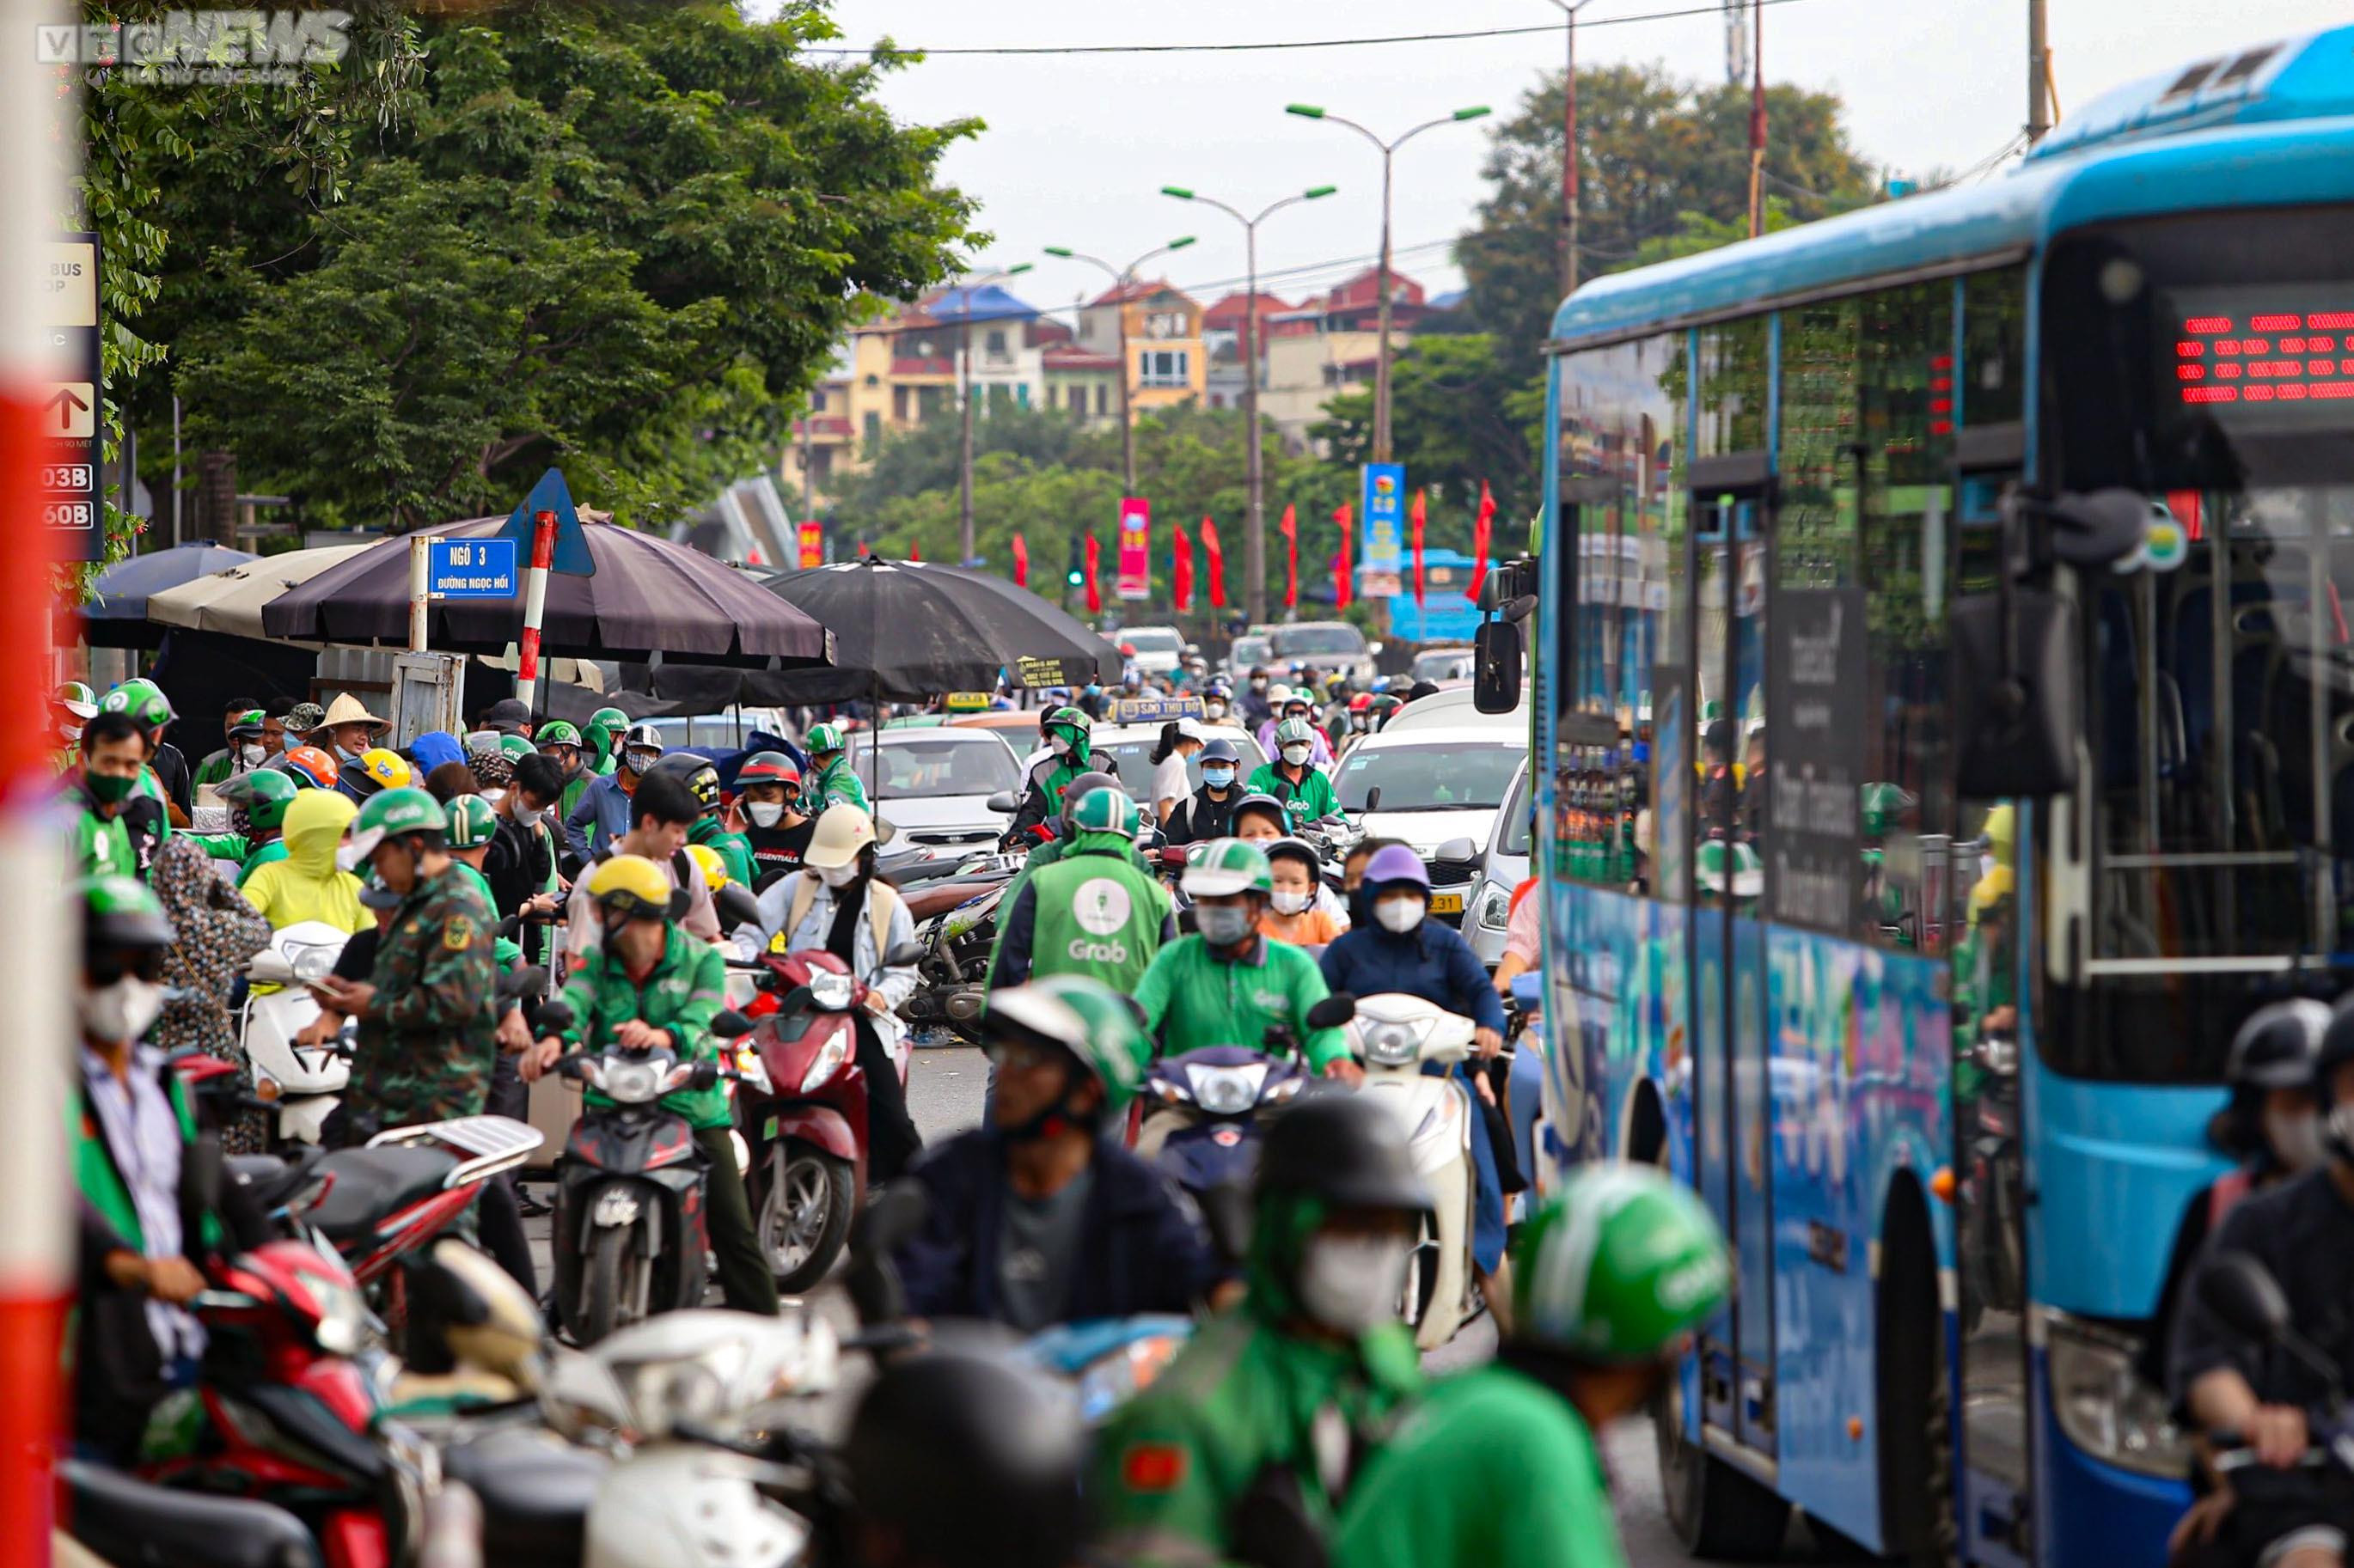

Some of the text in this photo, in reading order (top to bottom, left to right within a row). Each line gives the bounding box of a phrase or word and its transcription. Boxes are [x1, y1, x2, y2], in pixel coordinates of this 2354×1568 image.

[449, 543, 486, 566] NGÕ 3
[468, 577, 492, 592] NGỌC
[504, 747, 525, 760] Gra
[1286, 800, 1310, 811] Grab
[754, 851, 799, 863] ESSENTIALS
[1068, 938, 1127, 964] Grab
